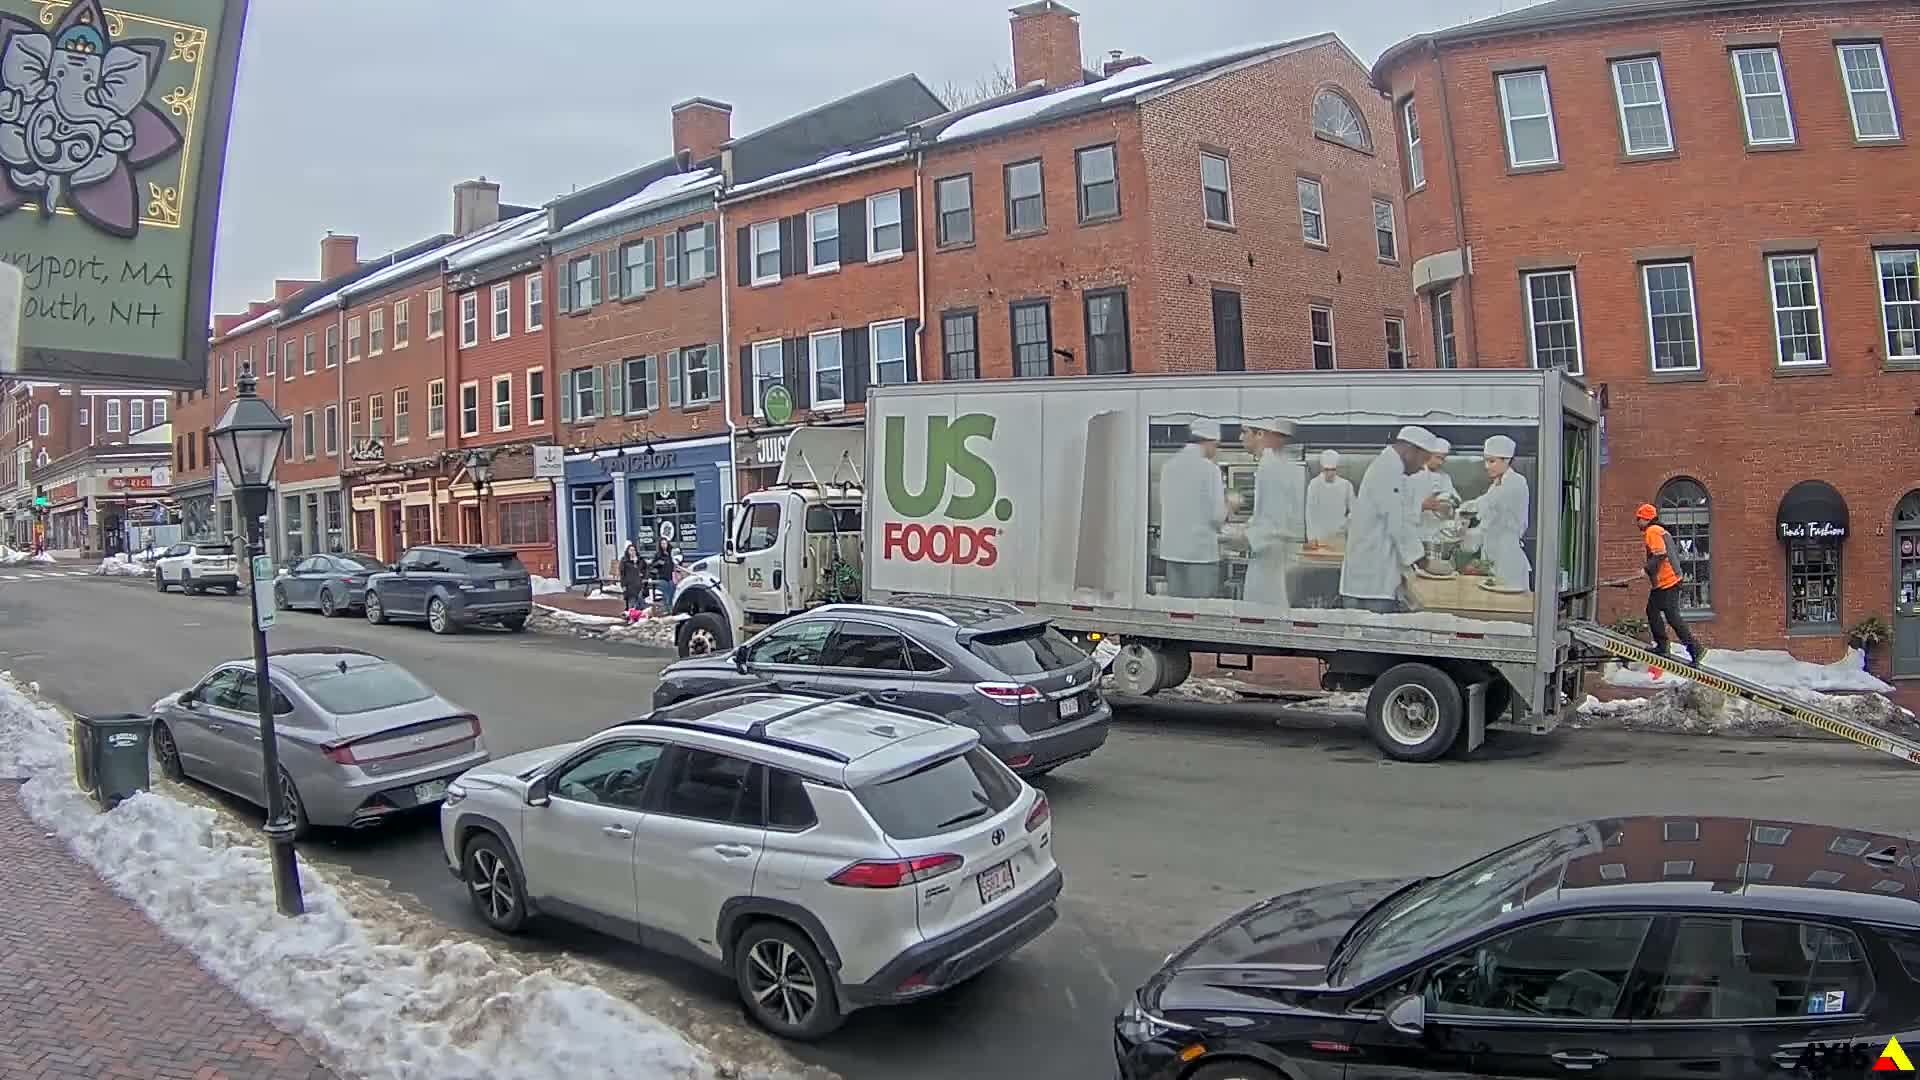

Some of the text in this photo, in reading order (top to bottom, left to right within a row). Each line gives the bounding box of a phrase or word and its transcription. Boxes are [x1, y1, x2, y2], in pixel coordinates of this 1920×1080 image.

[0, 251, 173, 290] ryport, MA
[24, 292, 163, 329] outh, NH
[884, 522, 998, 567] FOODS
[1781, 521, 1804, 537] Tina's
